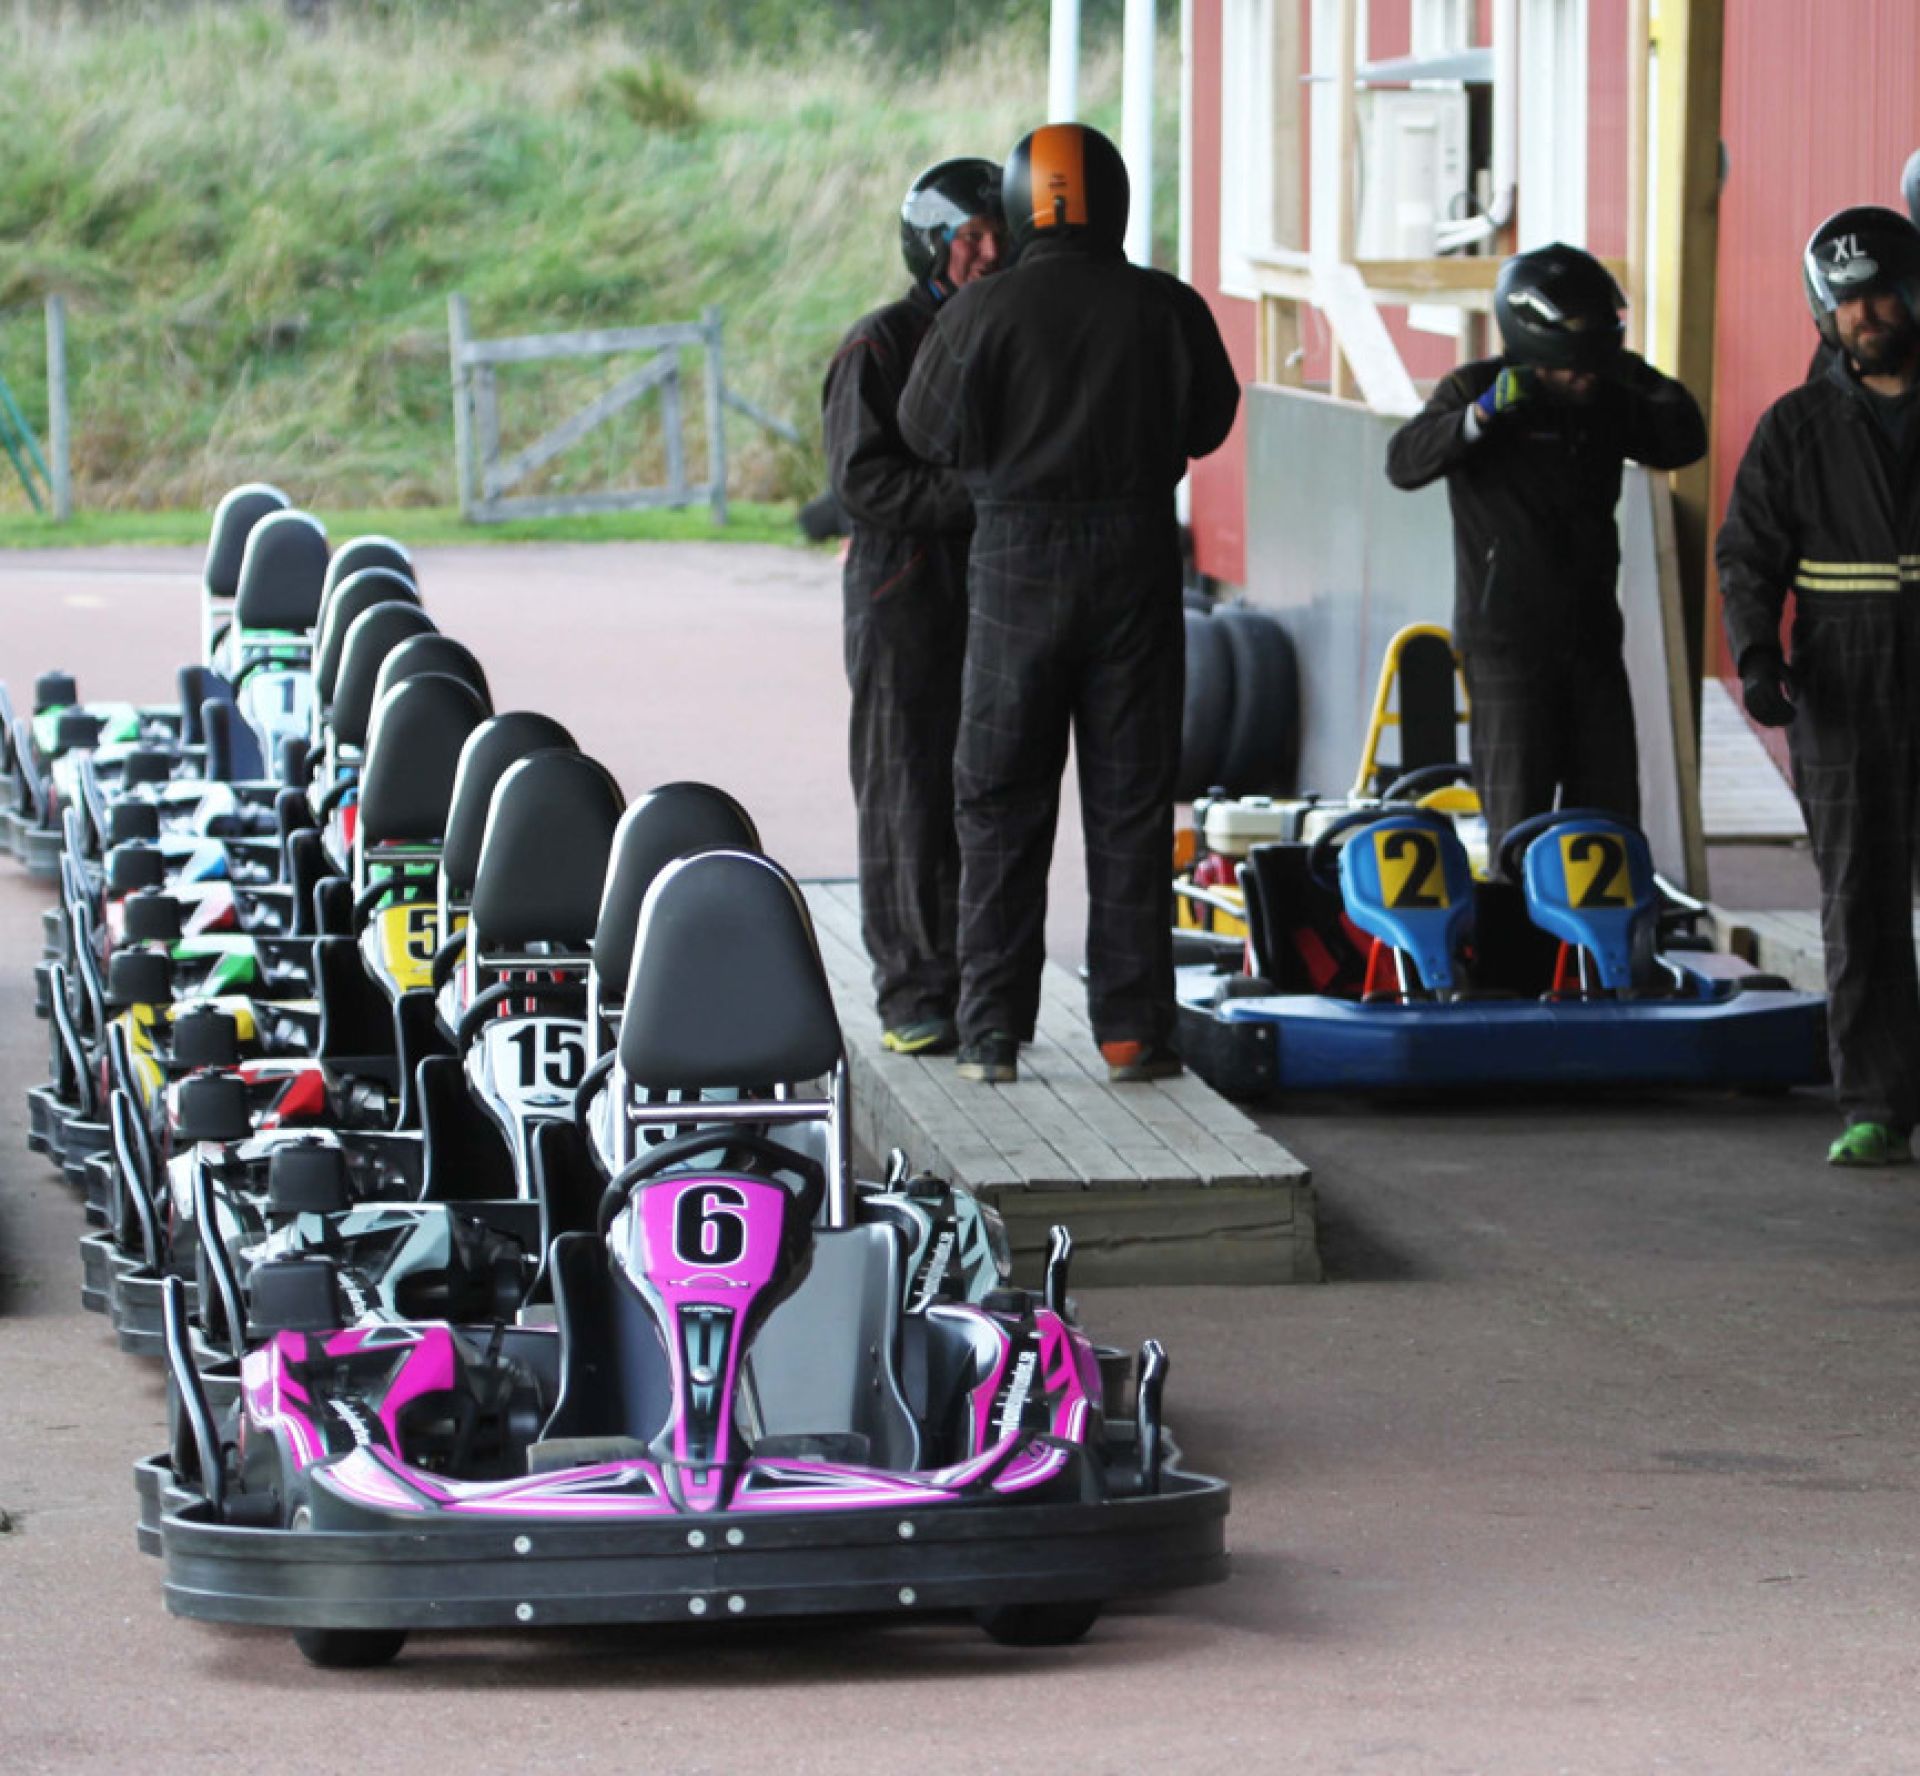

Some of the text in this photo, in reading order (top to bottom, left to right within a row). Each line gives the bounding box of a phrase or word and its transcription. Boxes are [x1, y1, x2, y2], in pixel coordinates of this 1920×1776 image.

[1833, 233, 1866, 262] XL
[1384, 832, 1442, 908] 2
[1569, 834, 1628, 908] 2
[408, 909, 440, 961] 5
[507, 1023, 586, 1089] 15
[673, 1182, 748, 1268] 6
